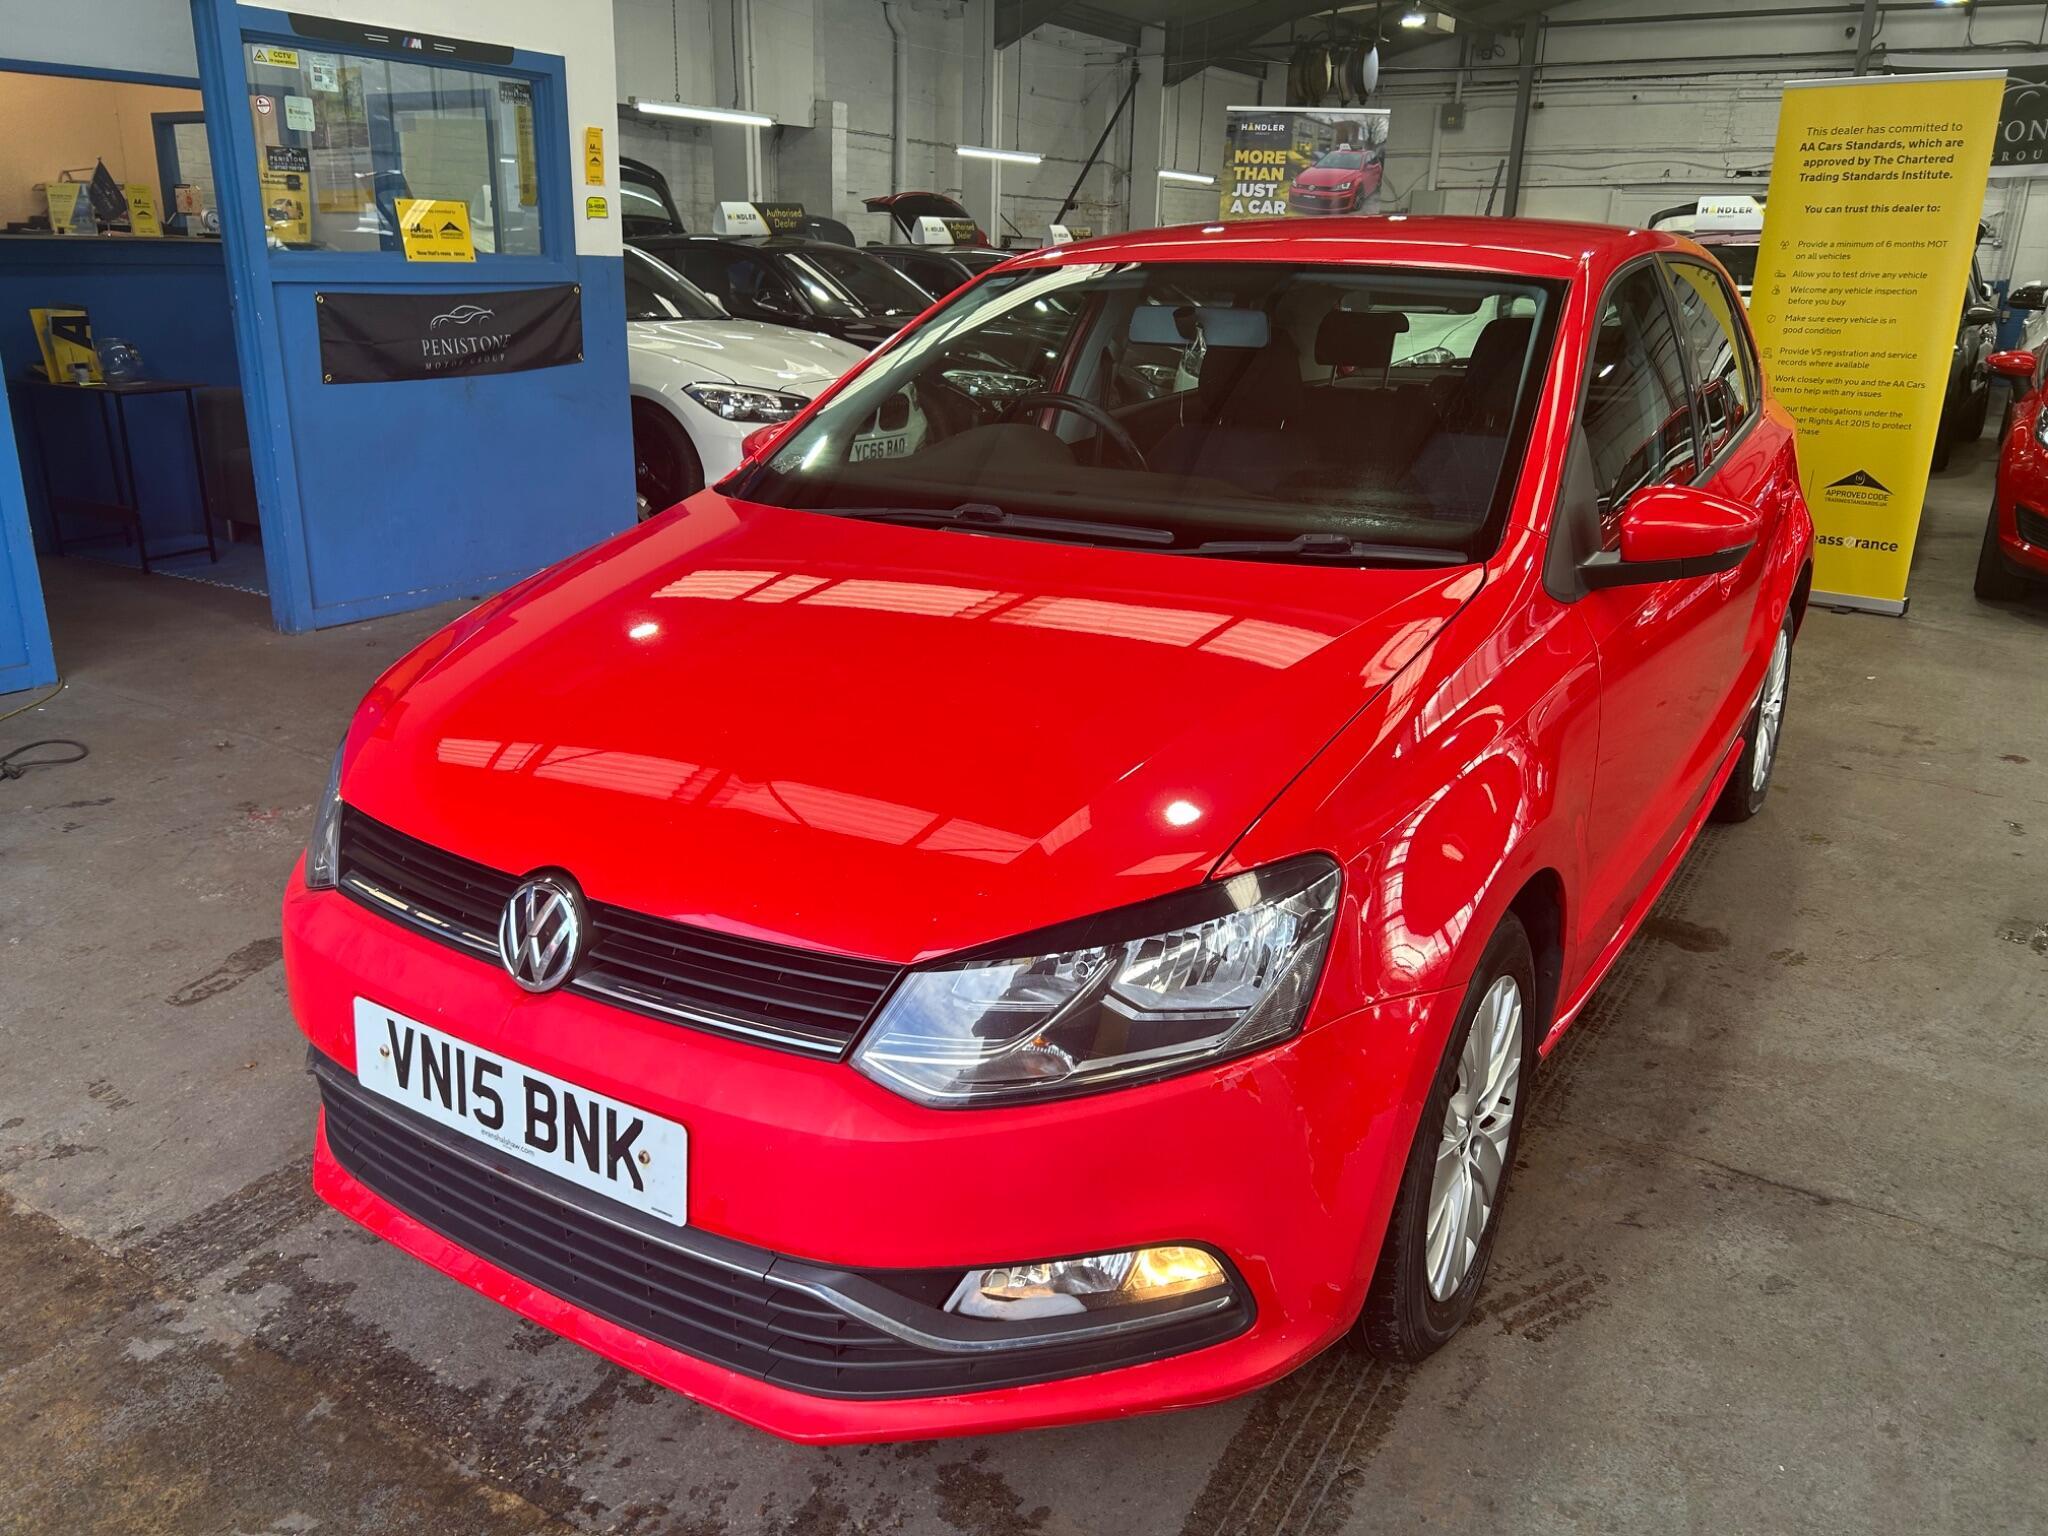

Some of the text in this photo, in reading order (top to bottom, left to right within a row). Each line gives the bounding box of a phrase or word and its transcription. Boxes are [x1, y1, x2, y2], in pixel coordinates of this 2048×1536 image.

[273, 51, 292, 59] CCTV
[1806, 122, 1963, 136] This dealer has committed to
[2004, 119, 2048, 142] ON
[1799, 139, 1964, 152] AA Cars Standards, which are
[1234, 150, 1287, 165] MORE
[1803, 154, 1954, 168] approved by The Chartered
[2001, 149, 2043, 162] ROU
[1233, 167, 1284, 181] THAN
[1799, 170, 1953, 183] Trading Standards Institute.
[1231, 183, 1278, 198] JUST
[766, 208, 802, 218] Authorised
[1230, 199, 1287, 215] A CAR
[1805, 205, 1822, 214] You
[1845, 205, 1869, 213] trust
[1871, 204, 1889, 213] this
[1892, 203, 1924, 213] dealer
[1927, 204, 1941, 212] to:
[775, 218, 797, 228] Dealer
[1798, 240, 1828, 248] Provide
[1836, 240, 1874, 248] minimum
[1875, 240, 1885, 248] of
[1886, 240, 1892, 248] 6
[1894, 240, 1925, 248] months
[1927, 240, 1949, 248] MOT
[1807, 252, 1818, 260] all
[1818, 252, 1851, 260] vehicles
[1792, 270, 1814, 278] Allow
[1816, 272, 1832, 280] you
[1860, 271, 1880, 279] drive
[1882, 273, 1897, 281] any
[1898, 271, 1928, 279] vehicle
[1790, 286, 1828, 294] Welcome
[1844, 287, 1873, 295] vehicle
[1875, 287, 1918, 297] inspection
[1788, 297, 1814, 305] before
[1831, 298, 1847, 307] buy
[1785, 314, 1806, 322] Make
[1826, 317, 1849, 325] every
[1850, 316, 1879, 324] vehicle
[1782, 326, 1841, 335] good condition
[421, 334, 512, 357] PENISTONE
[1780, 347, 1809, 355] Provide
[1810, 348, 1822, 356] V5
[1823, 349, 1869, 359] registration
[1870, 350, 1886, 358] and
[1777, 359, 1870, 369] records where available
[1775, 375, 1926, 389] Work closely with you and the AA Cars
[1773, 386, 1792, 394] team
[1803, 387, 1820, 396] help
[1822, 388, 1839, 396] with
[1841, 390, 1855, 398] any
[1857, 390, 1882, 398] issues
[1819, 407, 1862, 417] obligations
[1864, 409, 1888, 417] under
[1889, 410, 1903, 418] the
[1808, 416, 1833, 426] Rights
[1835, 418, 1849, 426] Act
[1850, 419, 1870, 428] 2015
[1872, 420, 1881, 428] to
[1882, 421, 1912, 431] protect
[854, 442, 884, 461] YC66
[1825, 489, 1889, 502] APPROVED CODE
[387, 1018, 645, 1193] VN15 BNK
